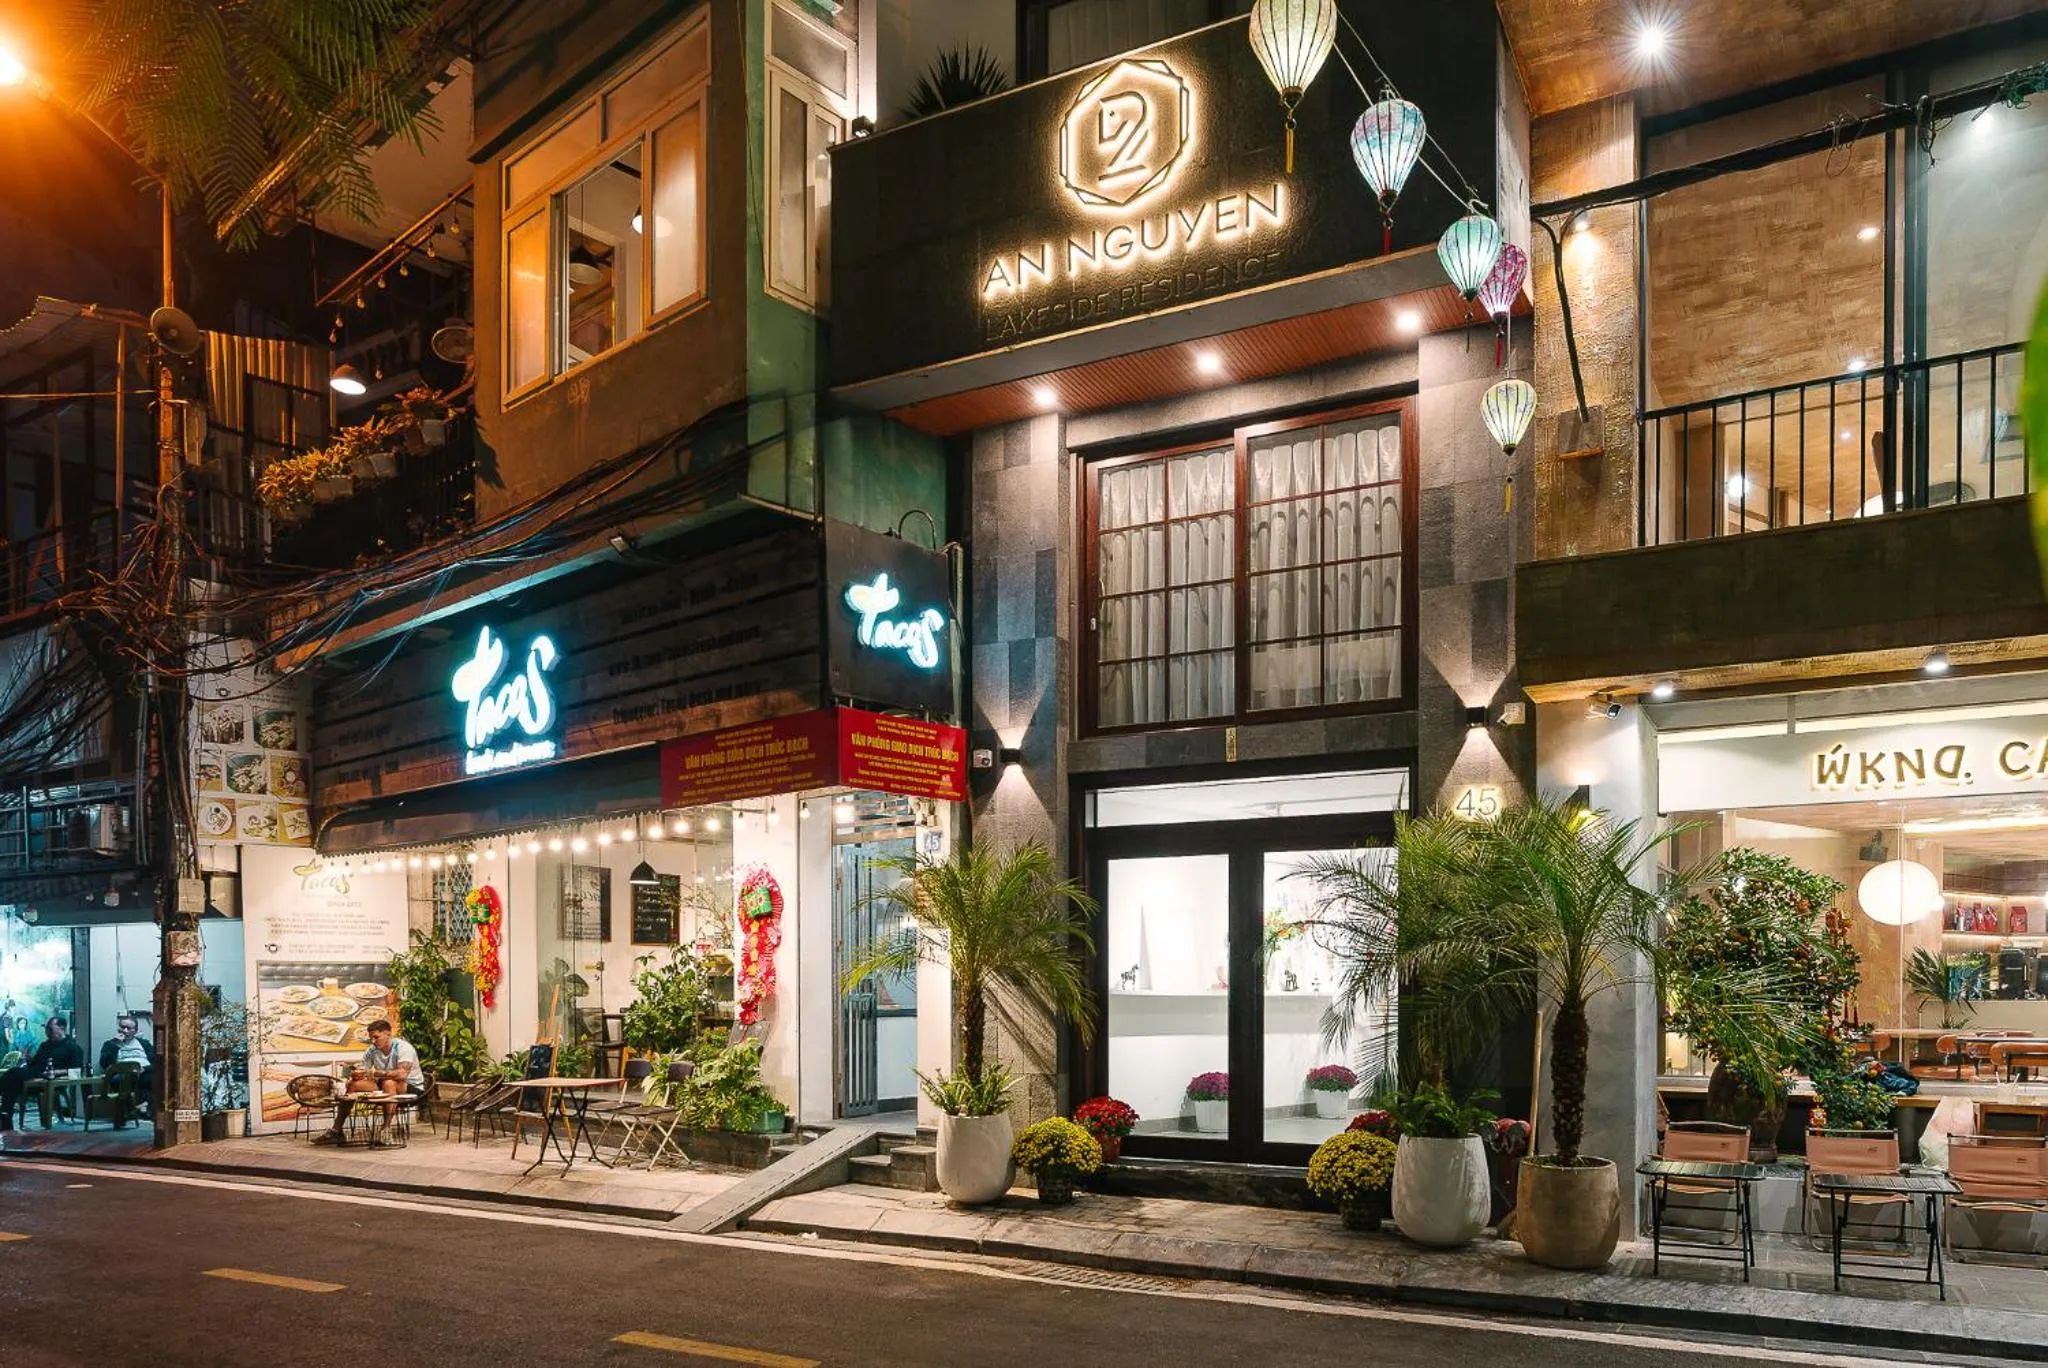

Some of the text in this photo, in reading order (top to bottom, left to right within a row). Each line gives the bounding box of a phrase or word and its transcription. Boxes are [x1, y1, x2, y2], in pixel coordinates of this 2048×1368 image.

[982, 183, 1279, 293] AN NGUYEN
[984, 251, 1281, 342] LAKESIDE RESIDENCE
[1456, 787, 1497, 816] 45
